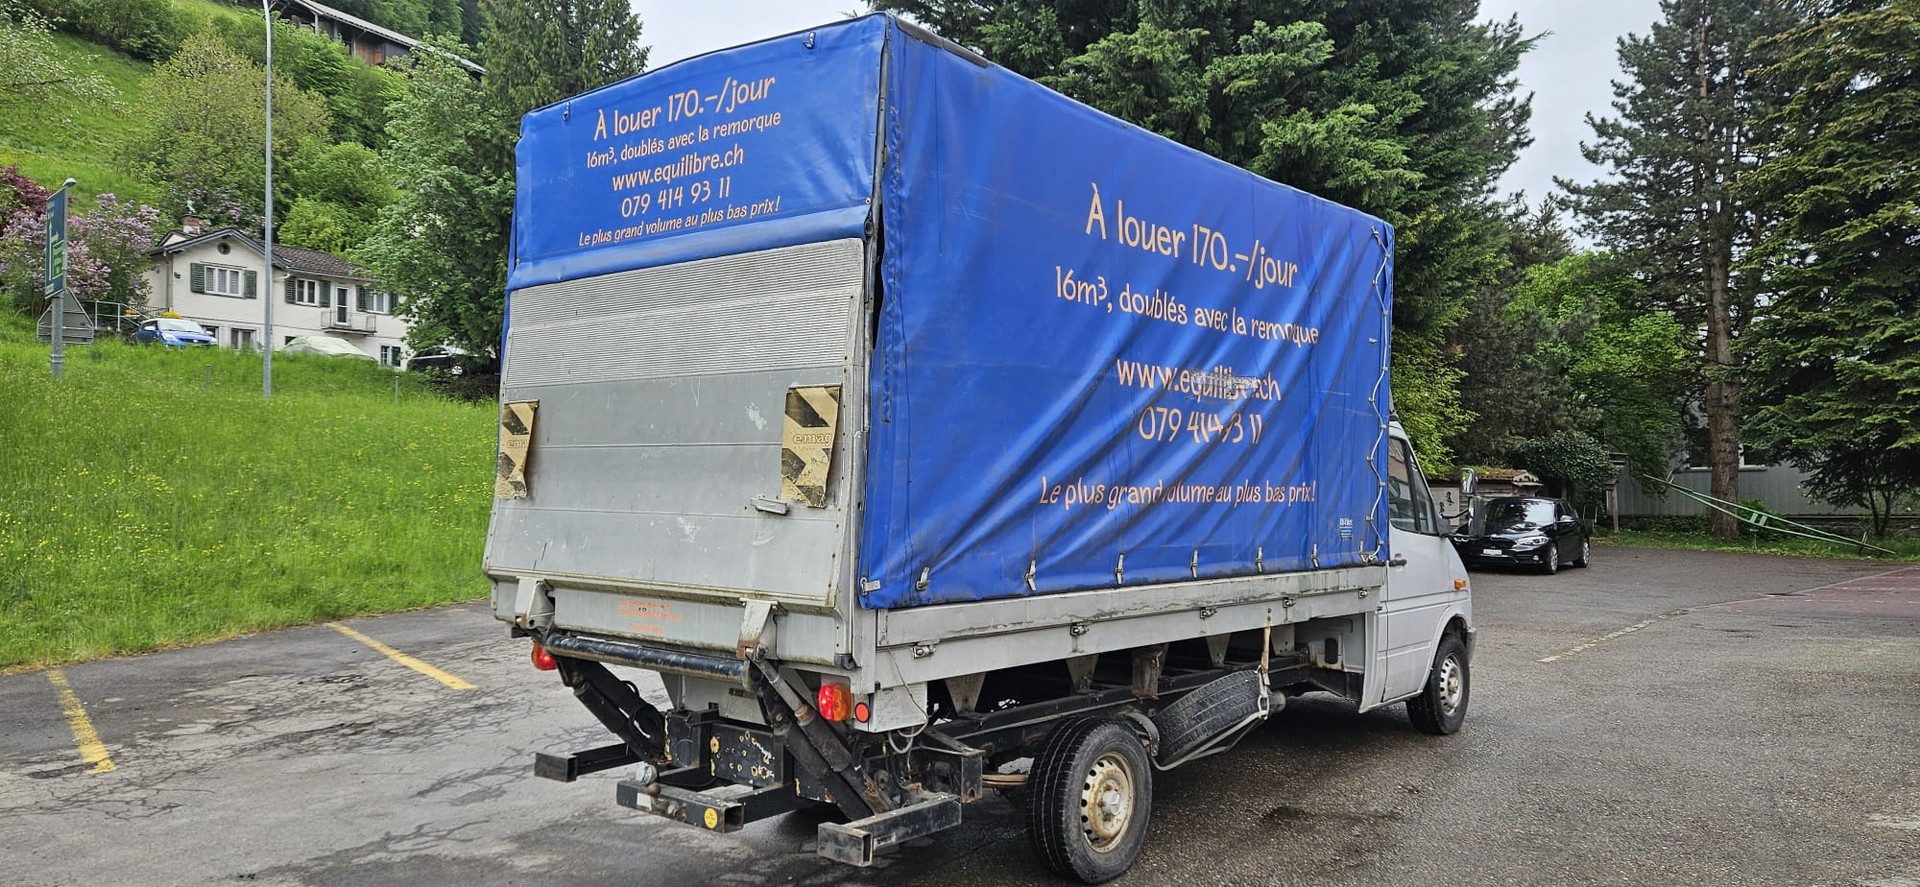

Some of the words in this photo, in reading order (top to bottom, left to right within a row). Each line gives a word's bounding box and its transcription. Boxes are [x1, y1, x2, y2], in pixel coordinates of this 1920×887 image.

[594, 109, 607, 141] À
[614, 106, 662, 136] louer
[668, 77, 776, 123] 170.-/jour
[621, 138, 665, 161] doublés
[668, 132, 695, 150] avec
[698, 125, 709, 142] la
[713, 112, 782, 139] remorque
[612, 143, 744, 192] www.equilibre.ch
[579, 232, 591, 247] Le
[592, 228, 613, 248] plus
[614, 221, 644, 243] grand
[646, 217, 682, 236] volume
[684, 215, 698, 228] au
[701, 207, 724, 228] plus
[727, 204, 748, 220] bas
[750, 195, 781, 219] prix!
[621, 193, 651, 218] 079
[657, 186, 684, 210] 414
[691, 180, 712, 205] 93
[719, 176, 731, 199] 11
[1085, 182, 1107, 240] À
[1117, 199, 1186, 258] louer
[1192, 223, 1298, 290] 170.-/jour
[1119, 282, 1188, 325] doublés
[1194, 307, 1228, 332] avec
[1232, 306, 1247, 336] la
[1138, 405, 1182, 443] 079
[1249, 413, 1263, 444] 11
[1039, 475, 1062, 504] Le
[1065, 476, 1106, 511] plus
[1107, 478, 1164, 511] grand
[1216, 485, 1232, 503] au
[1234, 478, 1261, 508] plus
[1265, 479, 1285, 503] bas
[1288, 480, 1317, 508] prix!
